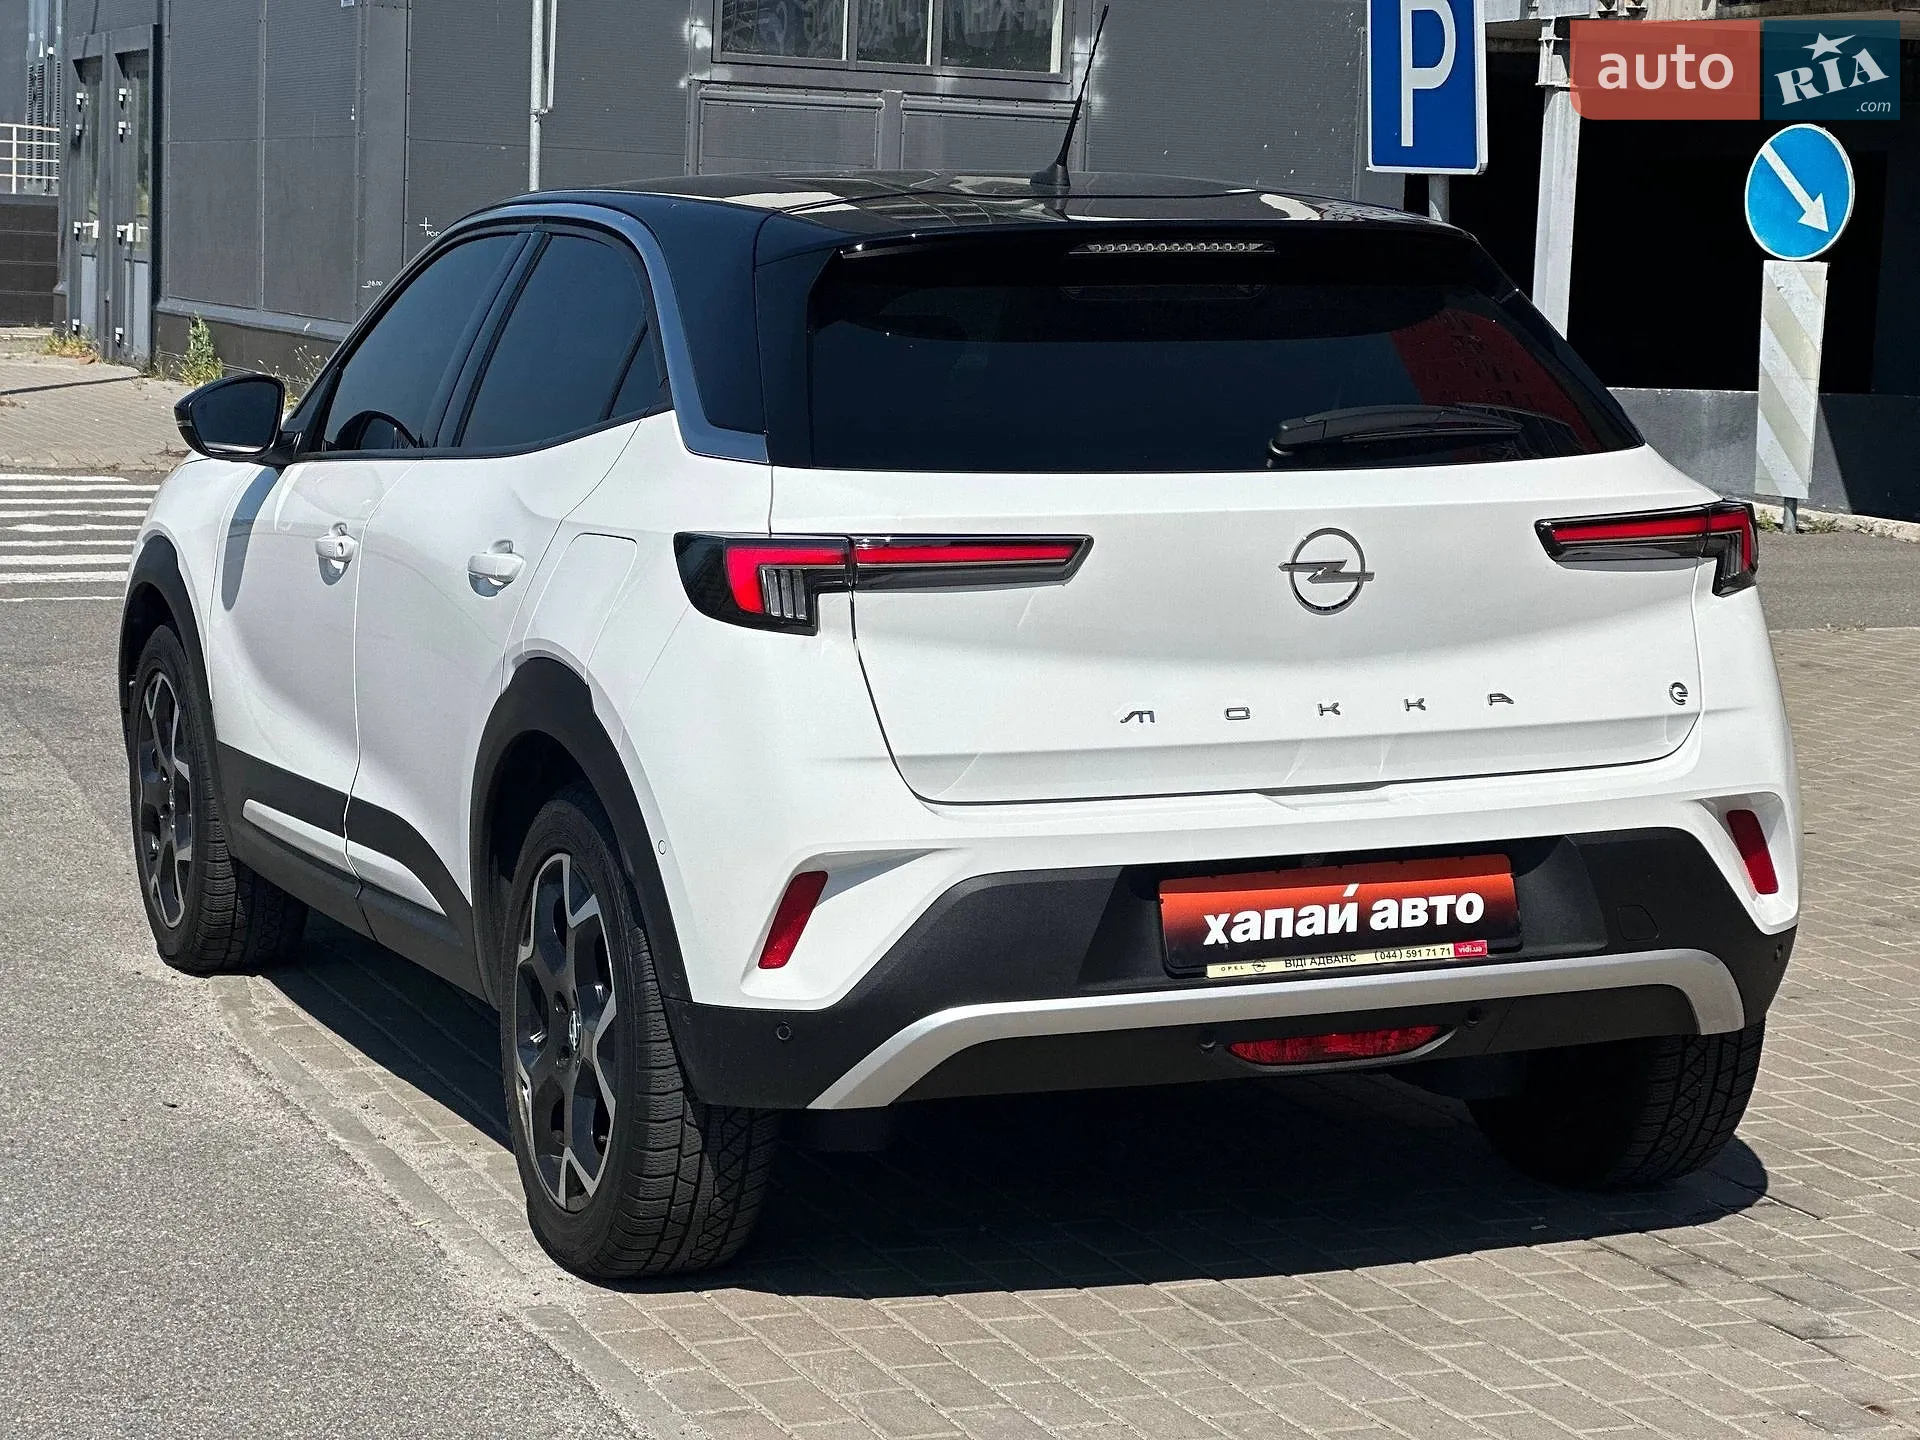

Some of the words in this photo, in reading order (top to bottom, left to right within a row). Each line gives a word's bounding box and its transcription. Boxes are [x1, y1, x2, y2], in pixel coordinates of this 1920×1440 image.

[1400, 0, 1456, 147] P
[1120, 692, 1515, 724] MOKKA
[1369, 892, 1485, 931] авто
[1284, 958, 1307, 968] ВІДІ
[1309, 953, 1357, 967] АДВАНС
[1374, 949, 1403, 961] (044)
[1405, 949, 1423, 958] 591
[1425, 948, 1437, 957] 71
[1440, 947, 1451, 956] 71
[1458, 944, 1483, 954] vidi.ua
